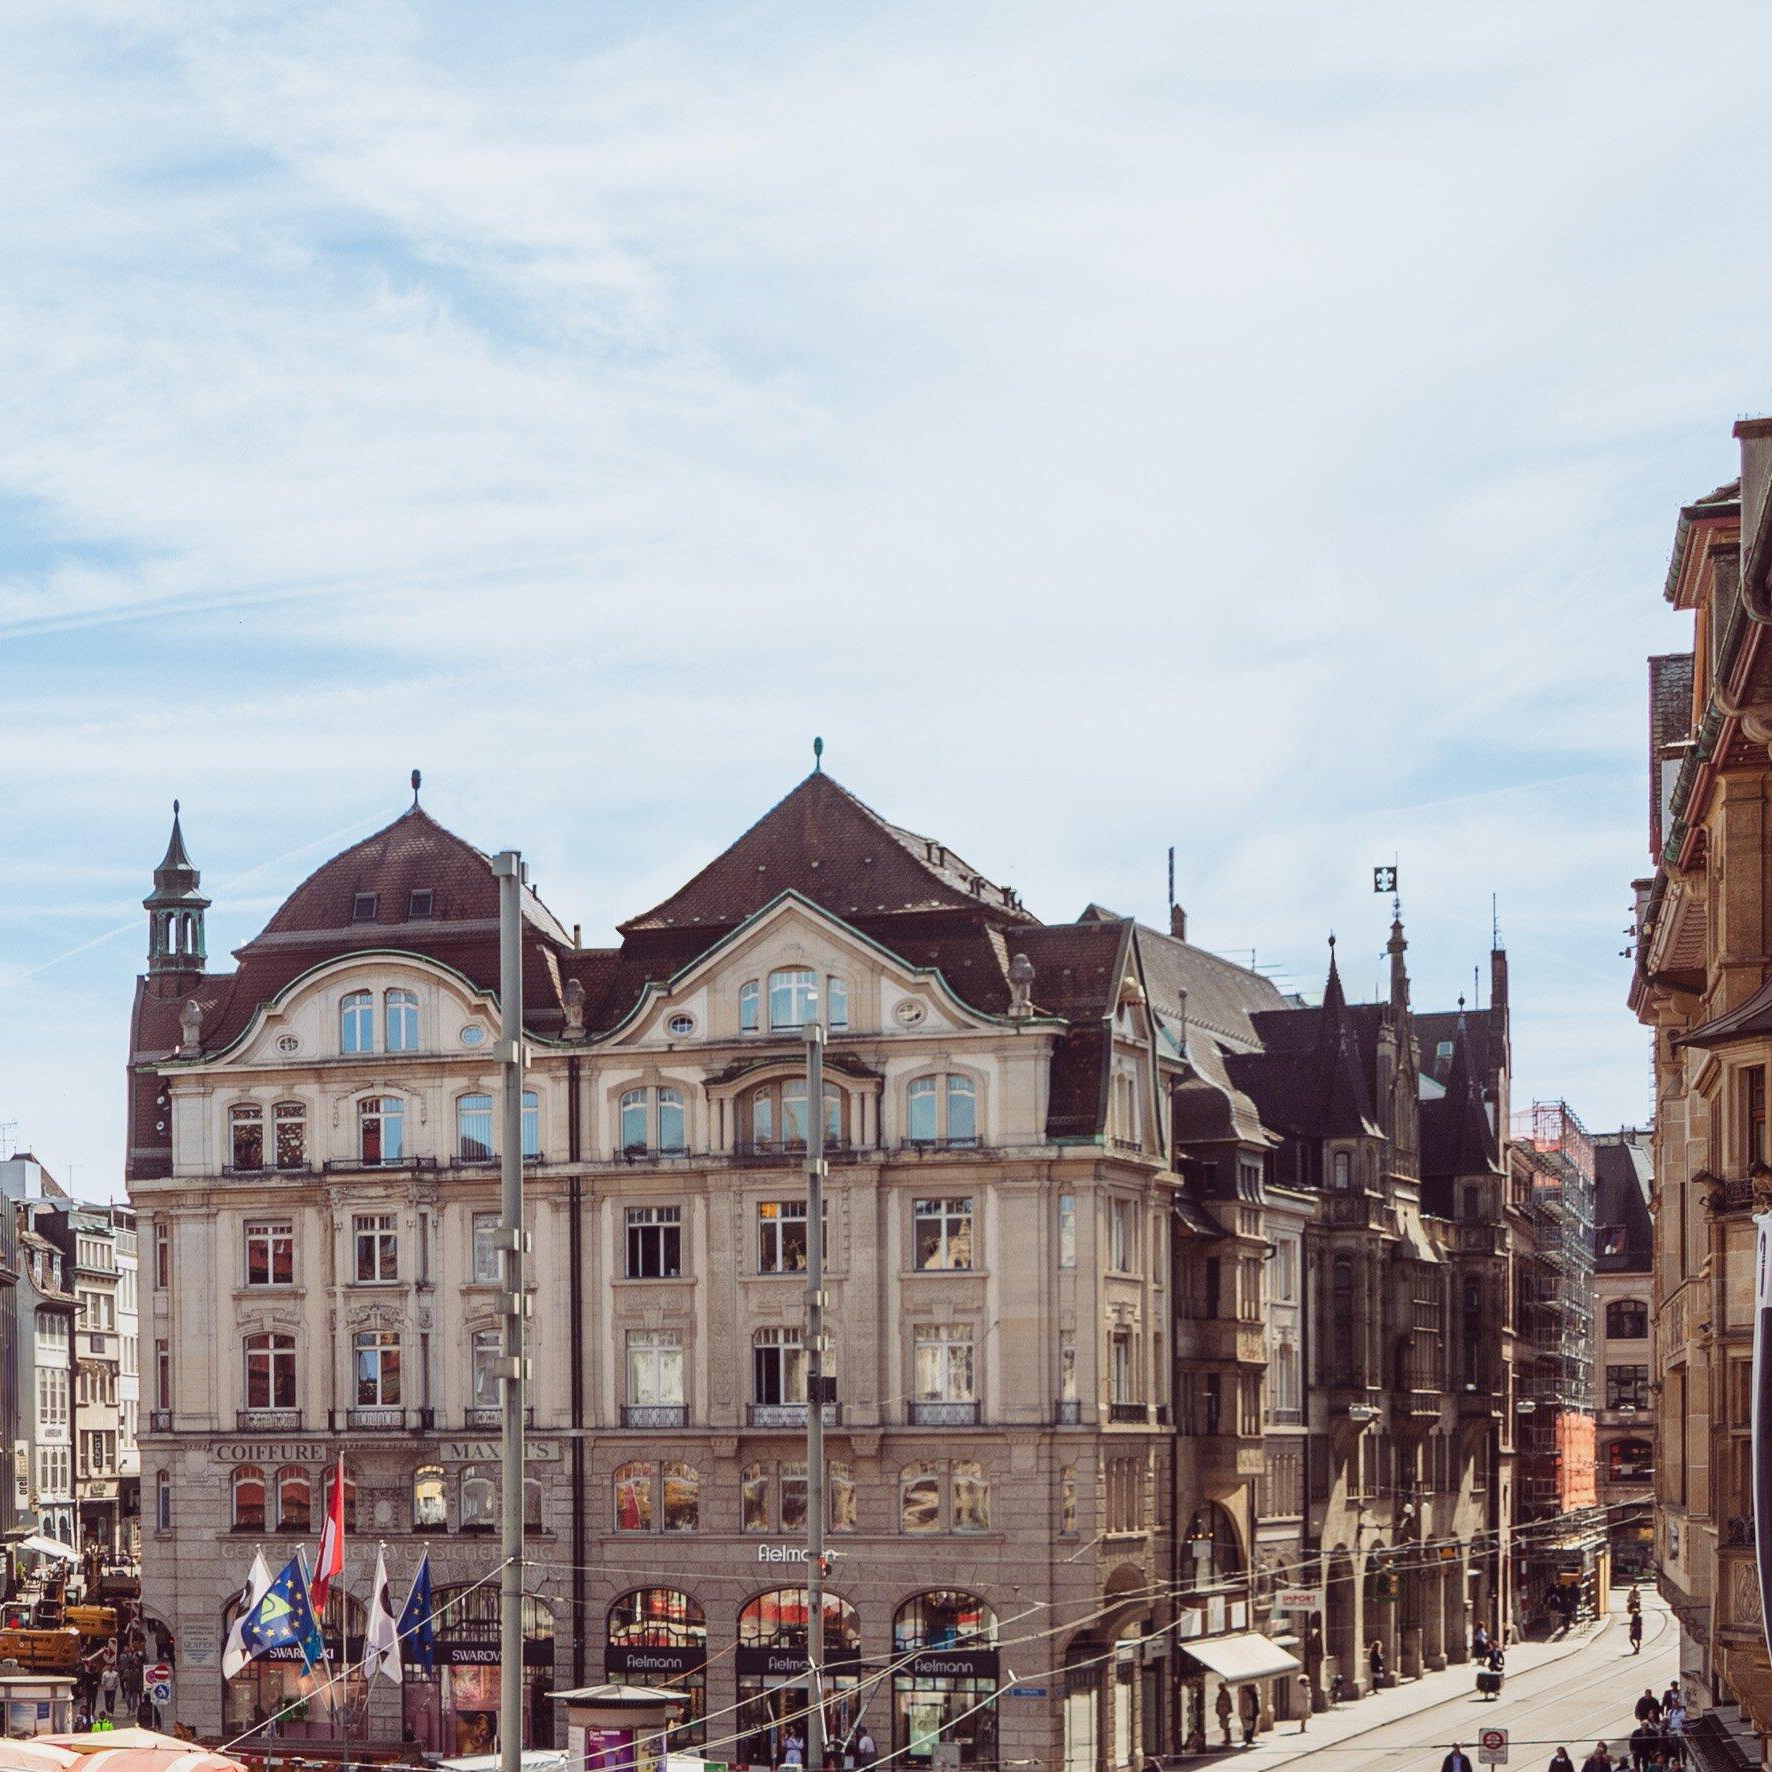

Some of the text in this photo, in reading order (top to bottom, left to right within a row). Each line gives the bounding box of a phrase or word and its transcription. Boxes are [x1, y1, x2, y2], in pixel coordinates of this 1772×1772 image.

[215, 1443, 550, 1462] COIFFURE MAX'S
[452, 1649, 503, 1662] SWAROV
